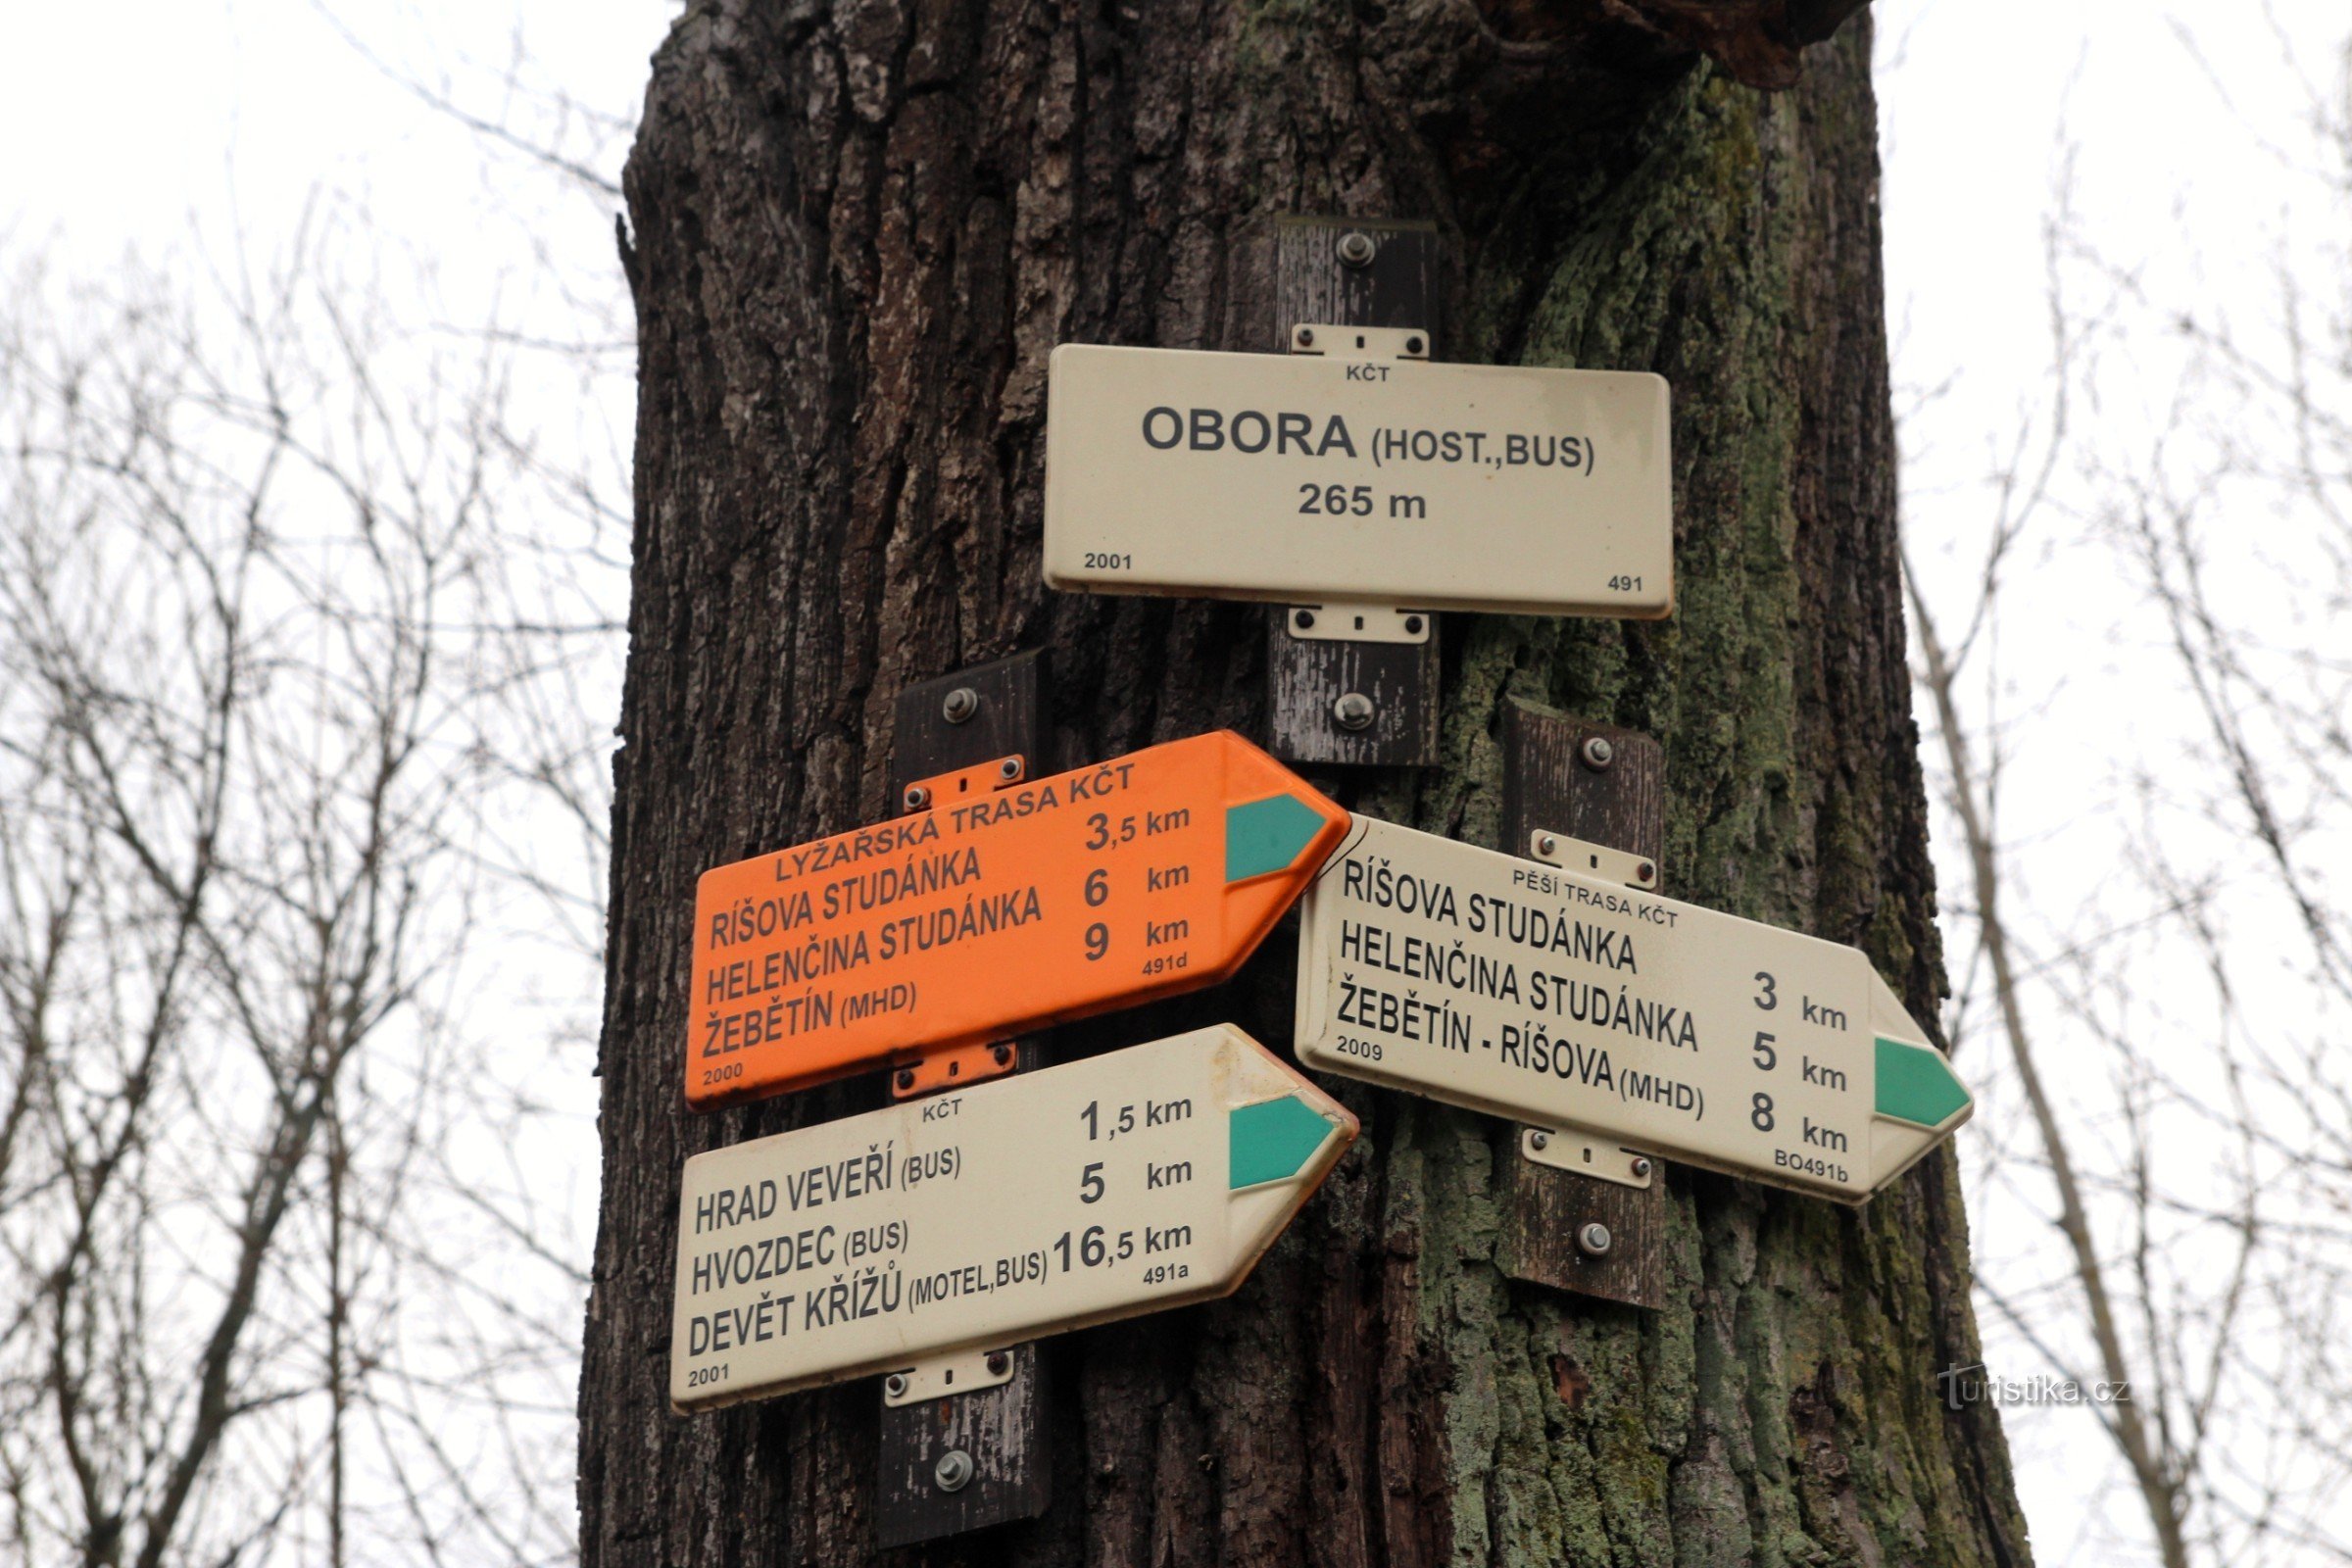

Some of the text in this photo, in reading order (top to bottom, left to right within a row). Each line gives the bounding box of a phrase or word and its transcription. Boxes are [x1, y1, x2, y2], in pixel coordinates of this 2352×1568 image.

[1347, 363, 1391, 382] KČT
[1142, 406, 1595, 476] OBORA (HOST.,BUS)
[1298, 483, 1427, 519] 265 m
[1084, 553, 1133, 570] 2001
[1608, 575, 1643, 593] 491
[775, 763, 1136, 883] LYŽAŘSKÁ TRASA KČT
[710, 806, 1191, 951] RÍŠOVA STUDÁNKA 3,5 km
[1512, 869, 1680, 929] PĚŠÍ TRASA KČT
[708, 862, 1191, 1006] HELENČINA STUDÁNKA 6 km
[1142, 952, 1188, 976] 491d
[1343, 856, 1847, 1032] RÍŠOVA STUDÁNKA 3 km
[703, 917, 1190, 1057] ŽEBĚTÍN (MHD) 9 km
[1341, 918, 1847, 1093] HELENČINA STUDÁNKA 5 km
[703, 1062, 744, 1086] 2000
[1337, 1035, 1383, 1062] 2009
[1337, 973, 1471, 1054] ŽEBĚTÍN
[1501, 1021, 1615, 1093] RÍŠOVA
[1619, 1067, 1705, 1122] (MHD)
[1750, 1092, 1776, 1133] 8
[1802, 1116, 1848, 1153] km
[921, 1098, 964, 1124] KČT
[695, 1096, 1194, 1235] HRAD VEVEŘÍ (BUS) 1,5 km
[1774, 1149, 1849, 1184] BO491b
[692, 1157, 1194, 1296] HVOZDEC (BUS) 5 km
[689, 1222, 1194, 1358] DEVĚT KŘÍŽŮ (MOTEL,BUS) 16,5 km
[1143, 1263, 1190, 1287] 491a
[687, 1363, 730, 1388] 2001
